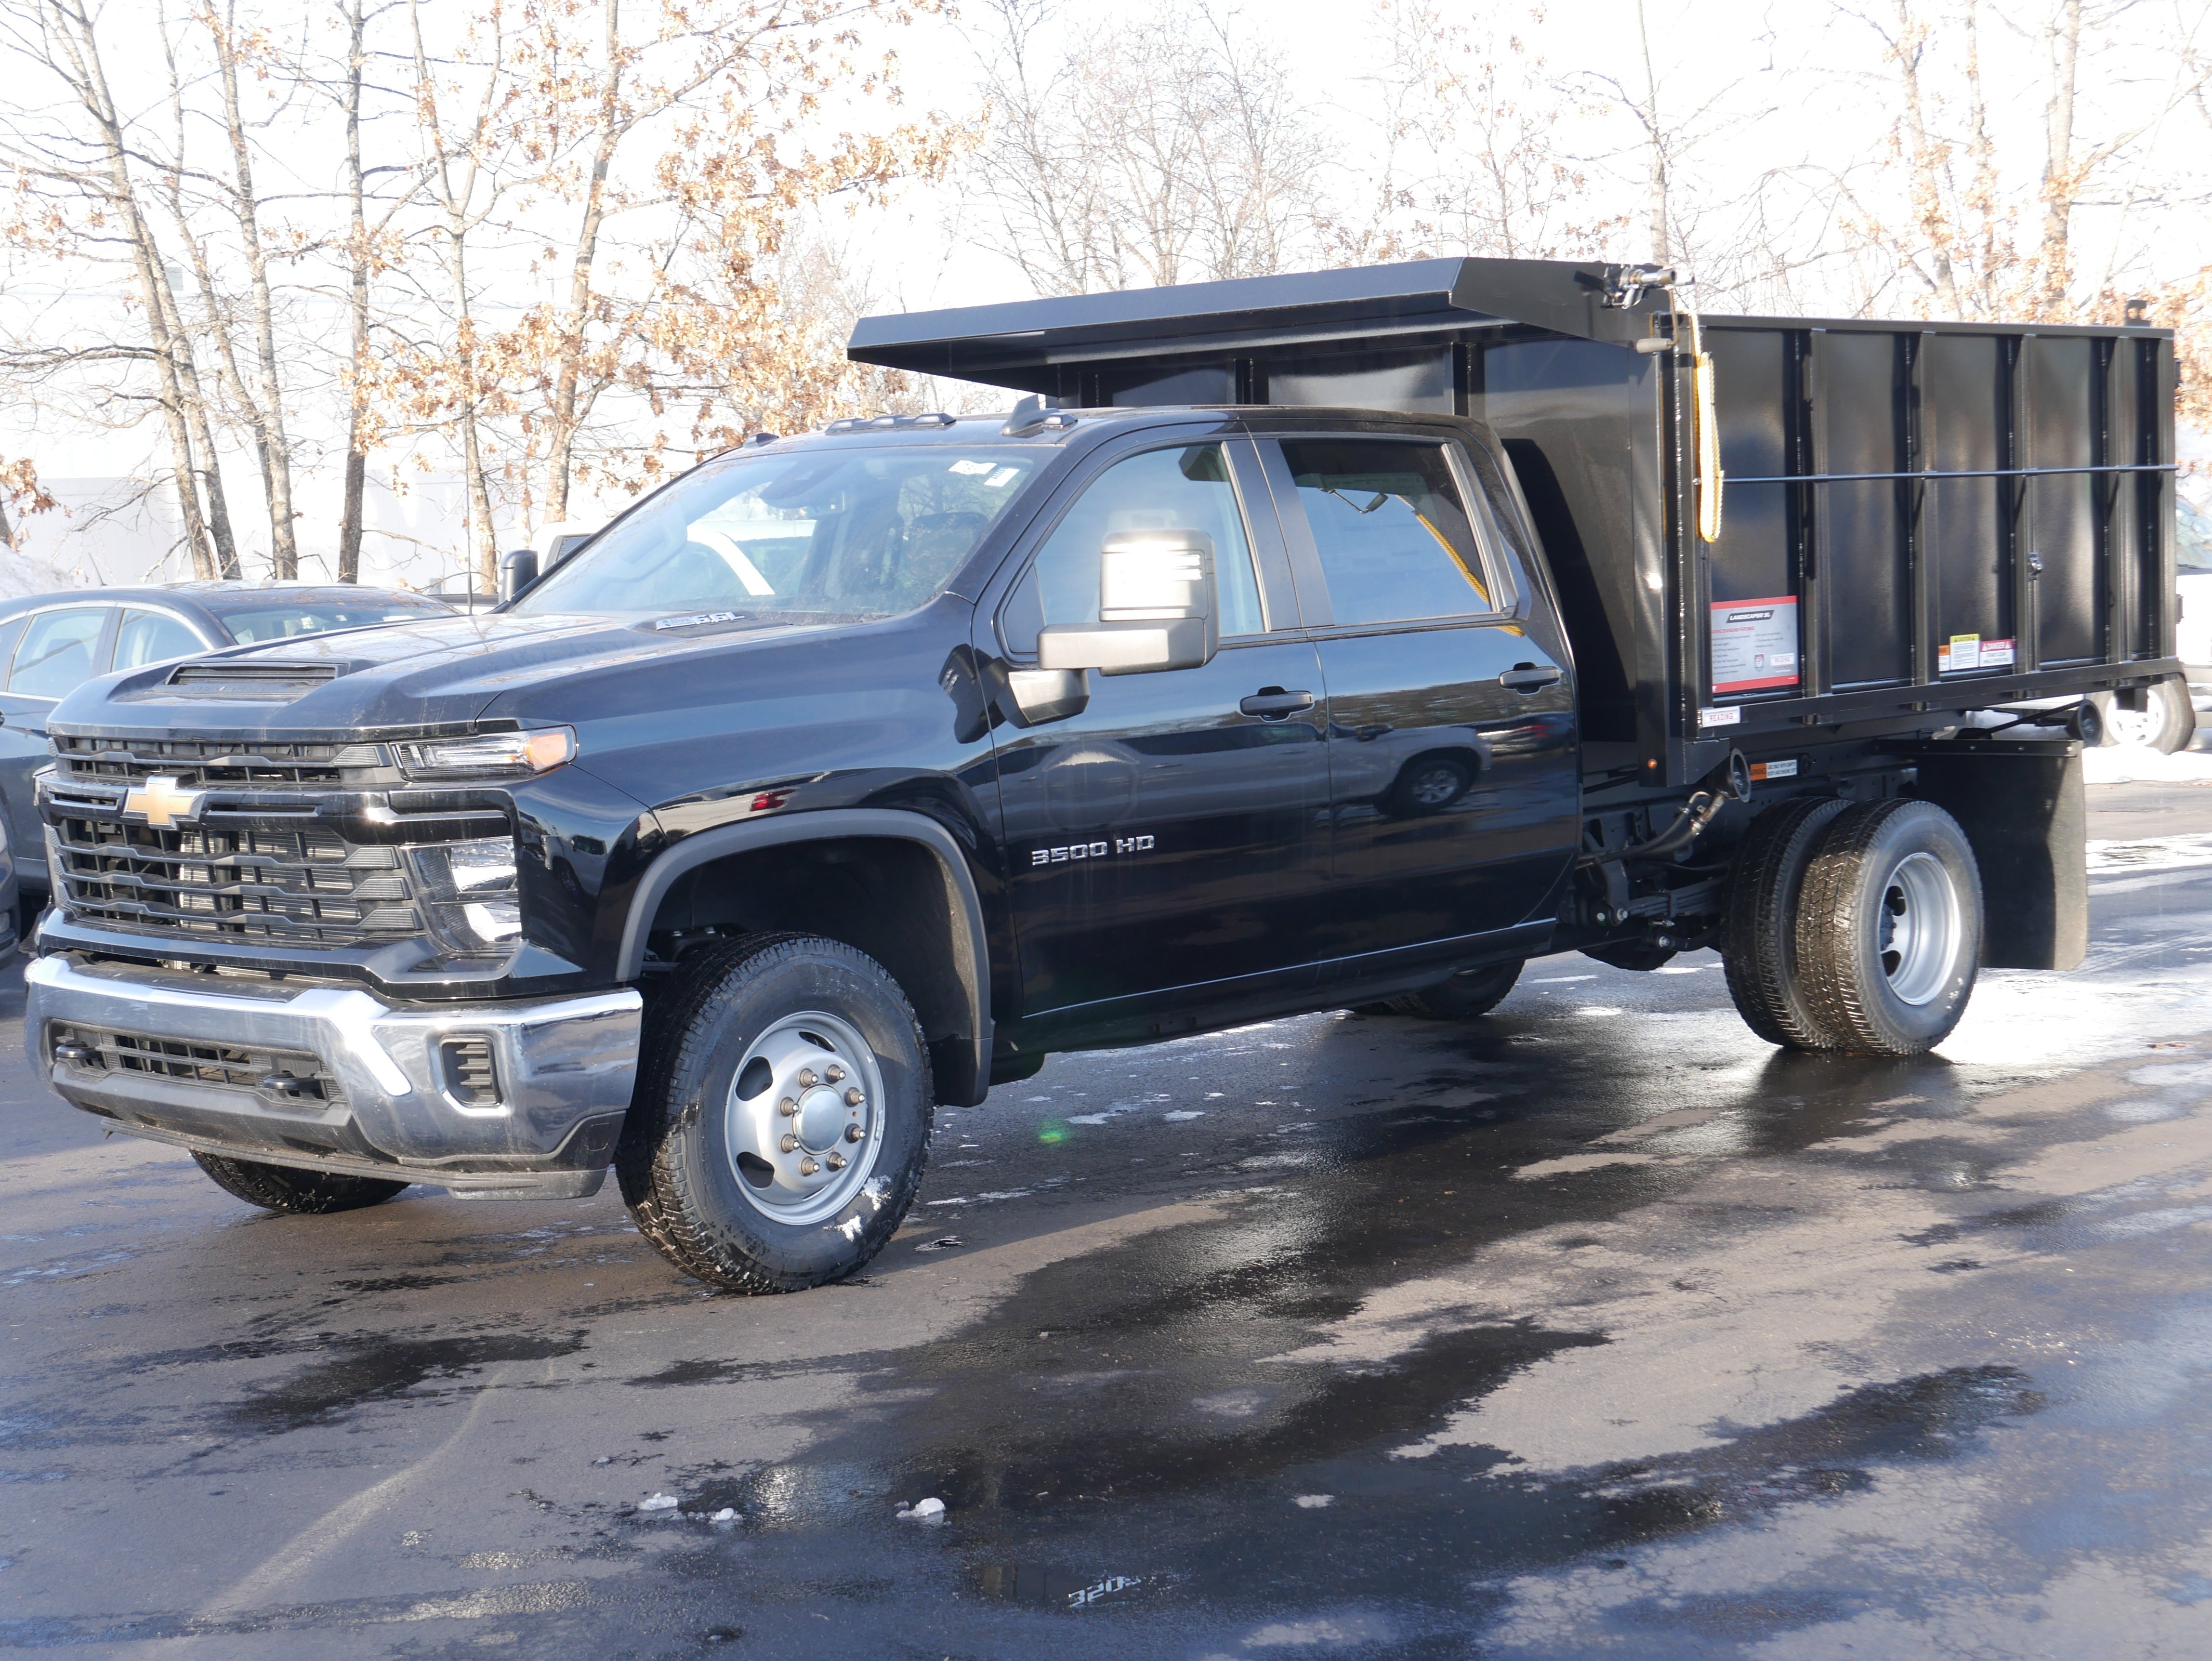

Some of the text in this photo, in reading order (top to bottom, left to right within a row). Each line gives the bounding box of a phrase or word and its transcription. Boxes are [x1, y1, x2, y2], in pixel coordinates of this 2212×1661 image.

[1987, 642, 2005, 650] DANGER
[1709, 713, 1734, 722] READING
[1750, 767, 1766, 776] ARNING
[1032, 835, 1155, 866] 3500 HD
